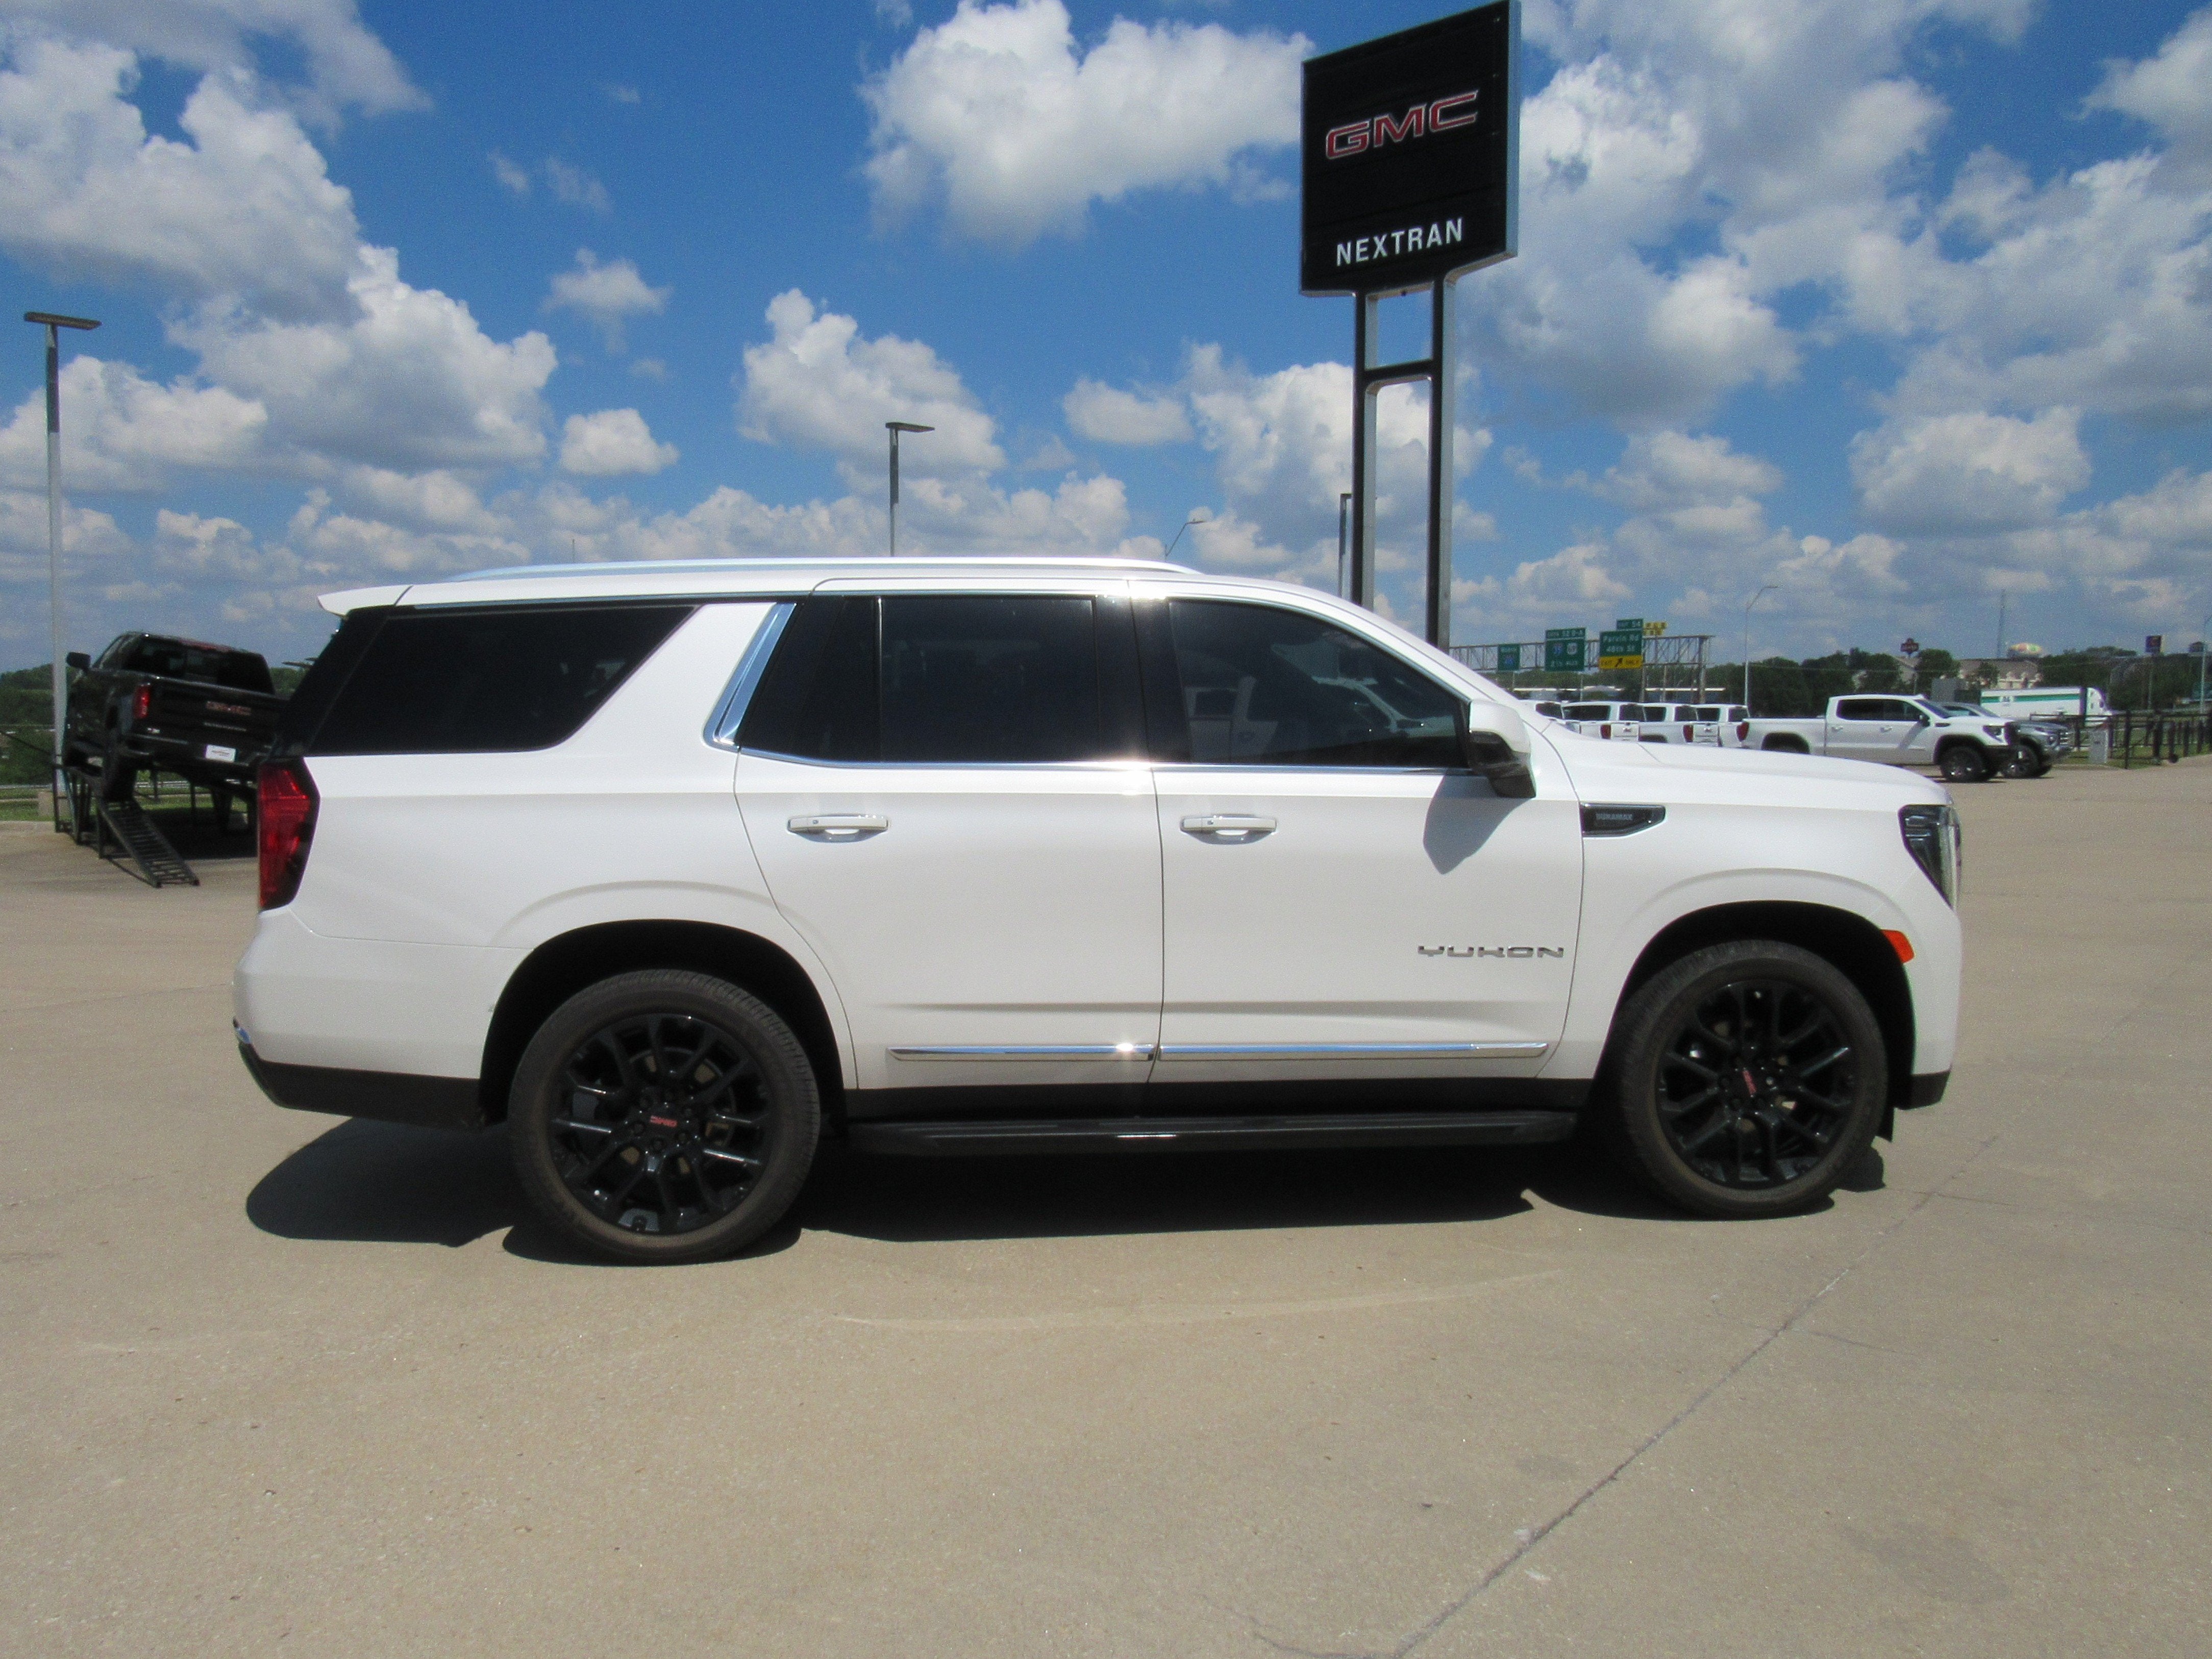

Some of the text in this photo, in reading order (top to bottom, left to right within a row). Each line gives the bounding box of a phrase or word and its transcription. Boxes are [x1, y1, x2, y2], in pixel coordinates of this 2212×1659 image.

[1326, 90, 1478, 159] GMC
[1336, 217, 1462, 266] NEXTRAN
[1418, 945, 1564, 958] YUKON
